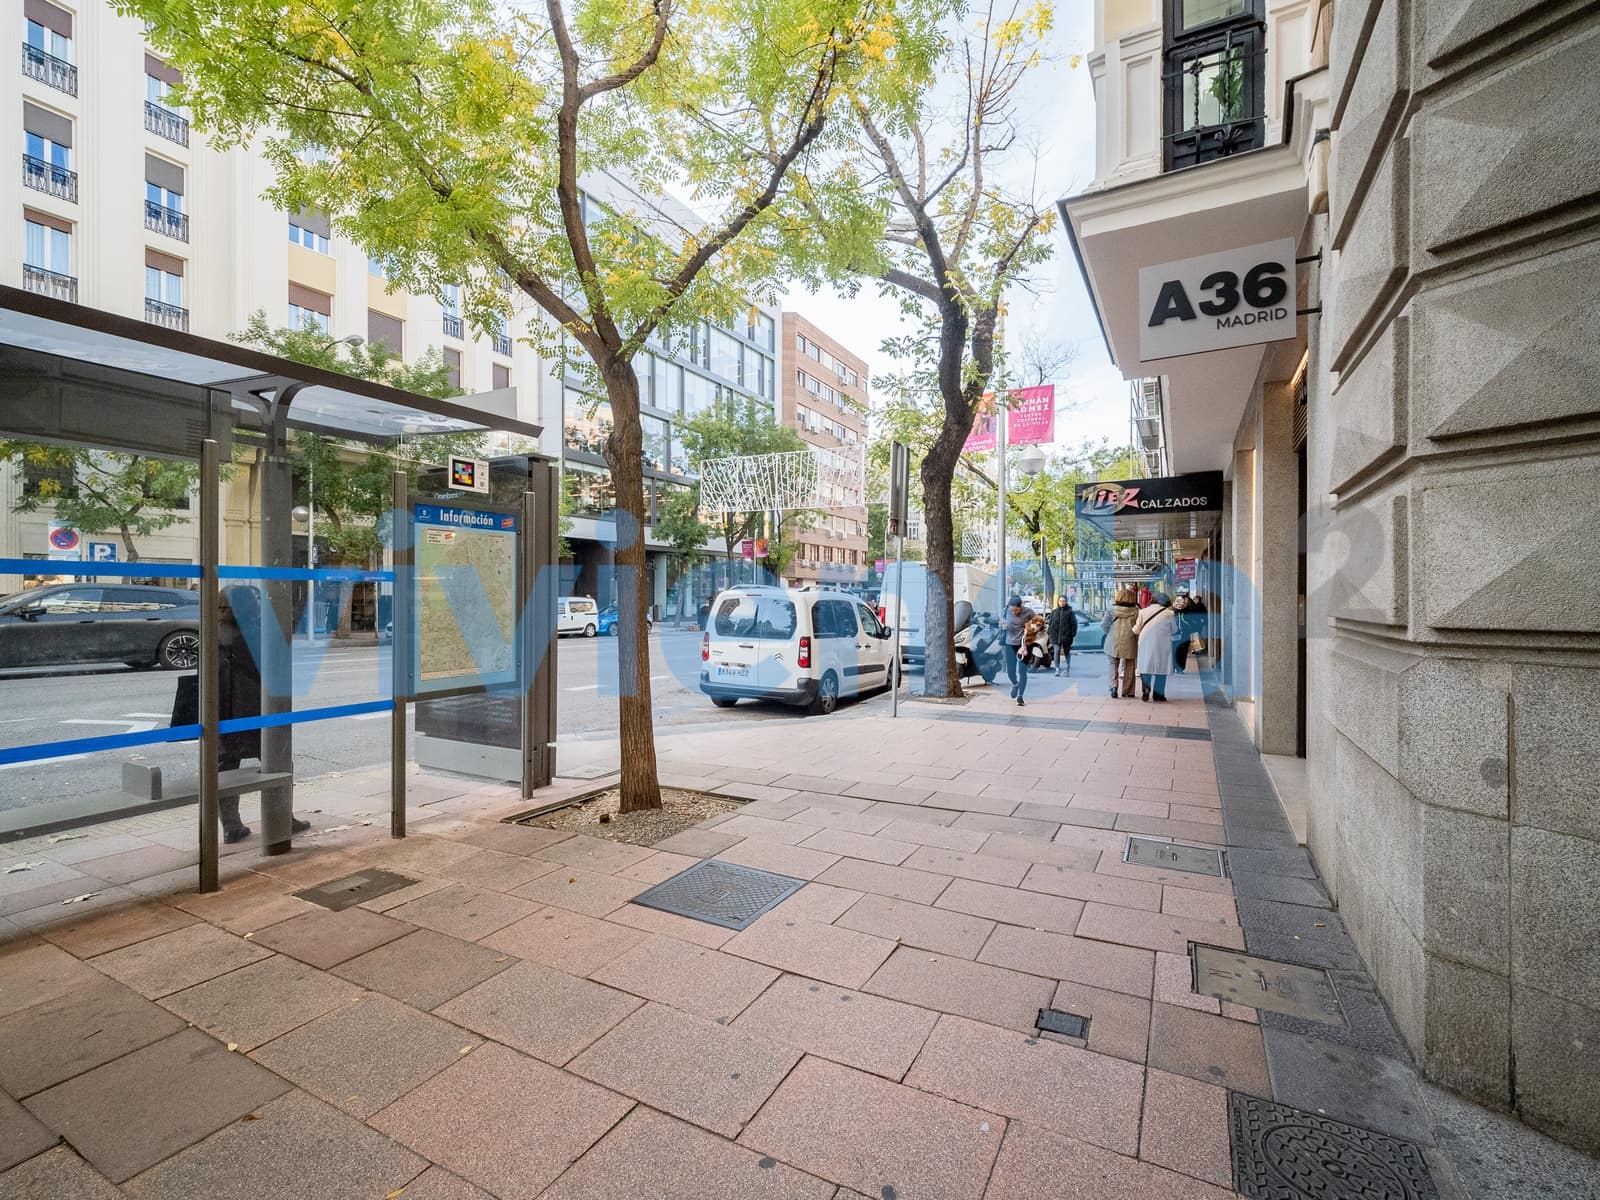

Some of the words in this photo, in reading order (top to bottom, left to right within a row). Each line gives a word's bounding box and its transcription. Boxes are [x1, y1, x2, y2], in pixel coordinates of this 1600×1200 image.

[1148, 262, 1287, 327] A36
[1217, 307, 1288, 330] MADRID
[1140, 496, 1208, 509] CALZADOS
[440, 509, 494, 526] Información
